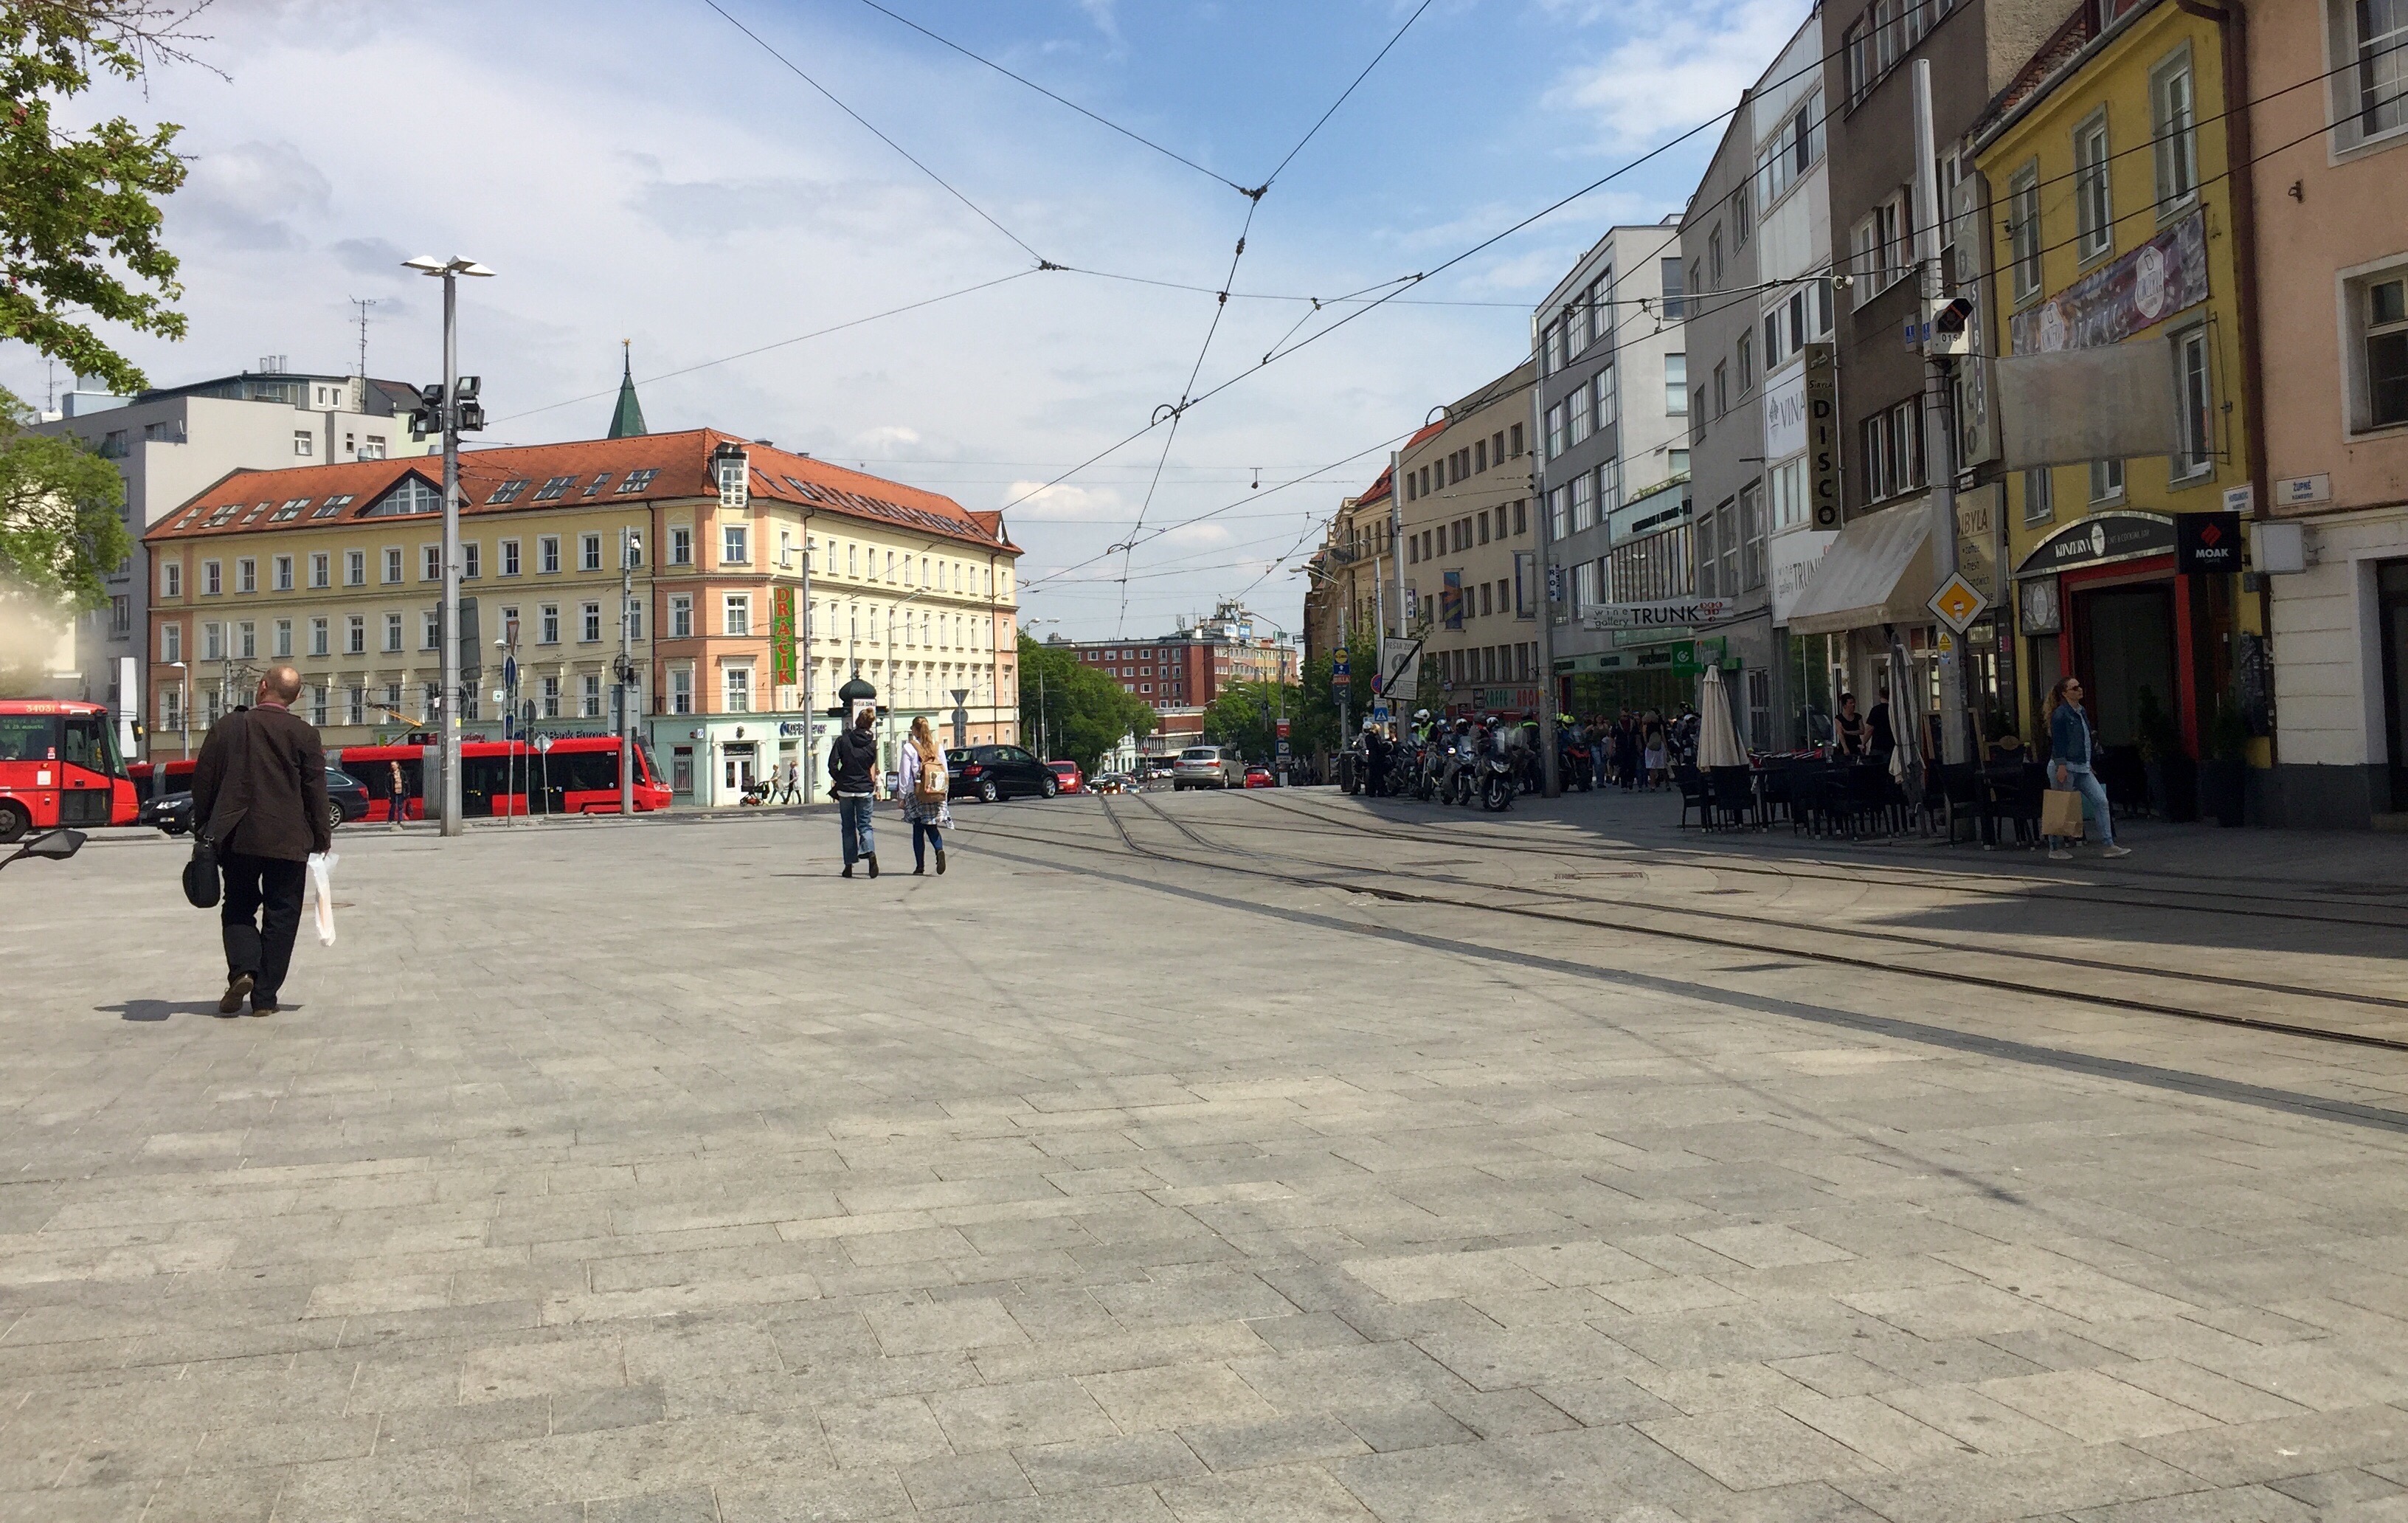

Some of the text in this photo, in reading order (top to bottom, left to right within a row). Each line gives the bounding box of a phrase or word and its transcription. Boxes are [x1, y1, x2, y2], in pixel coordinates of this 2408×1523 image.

[1942, 334, 1958, 342] 015
[1958, 249, 1976, 455] DCO
[1971, 284, 1984, 415] SIBYLA
[1813, 400, 1836, 525] DISCO
[1957, 502, 1987, 535] IBYLA
[2196, 548, 2229, 559] MOAK
[1793, 557, 1824, 590] TRUN
[1594, 607, 1628, 616] wine
[1631, 605, 1700, 624] TRUNK
[1595, 616, 1628, 629] gallery
[776, 588, 794, 685] DRÁČIK
[1385, 640, 1402, 649] PEŠIA
[25, 705, 55, 713] 34031
[461, 733, 485, 741] cabana
[550, 730, 573, 739] Bank
